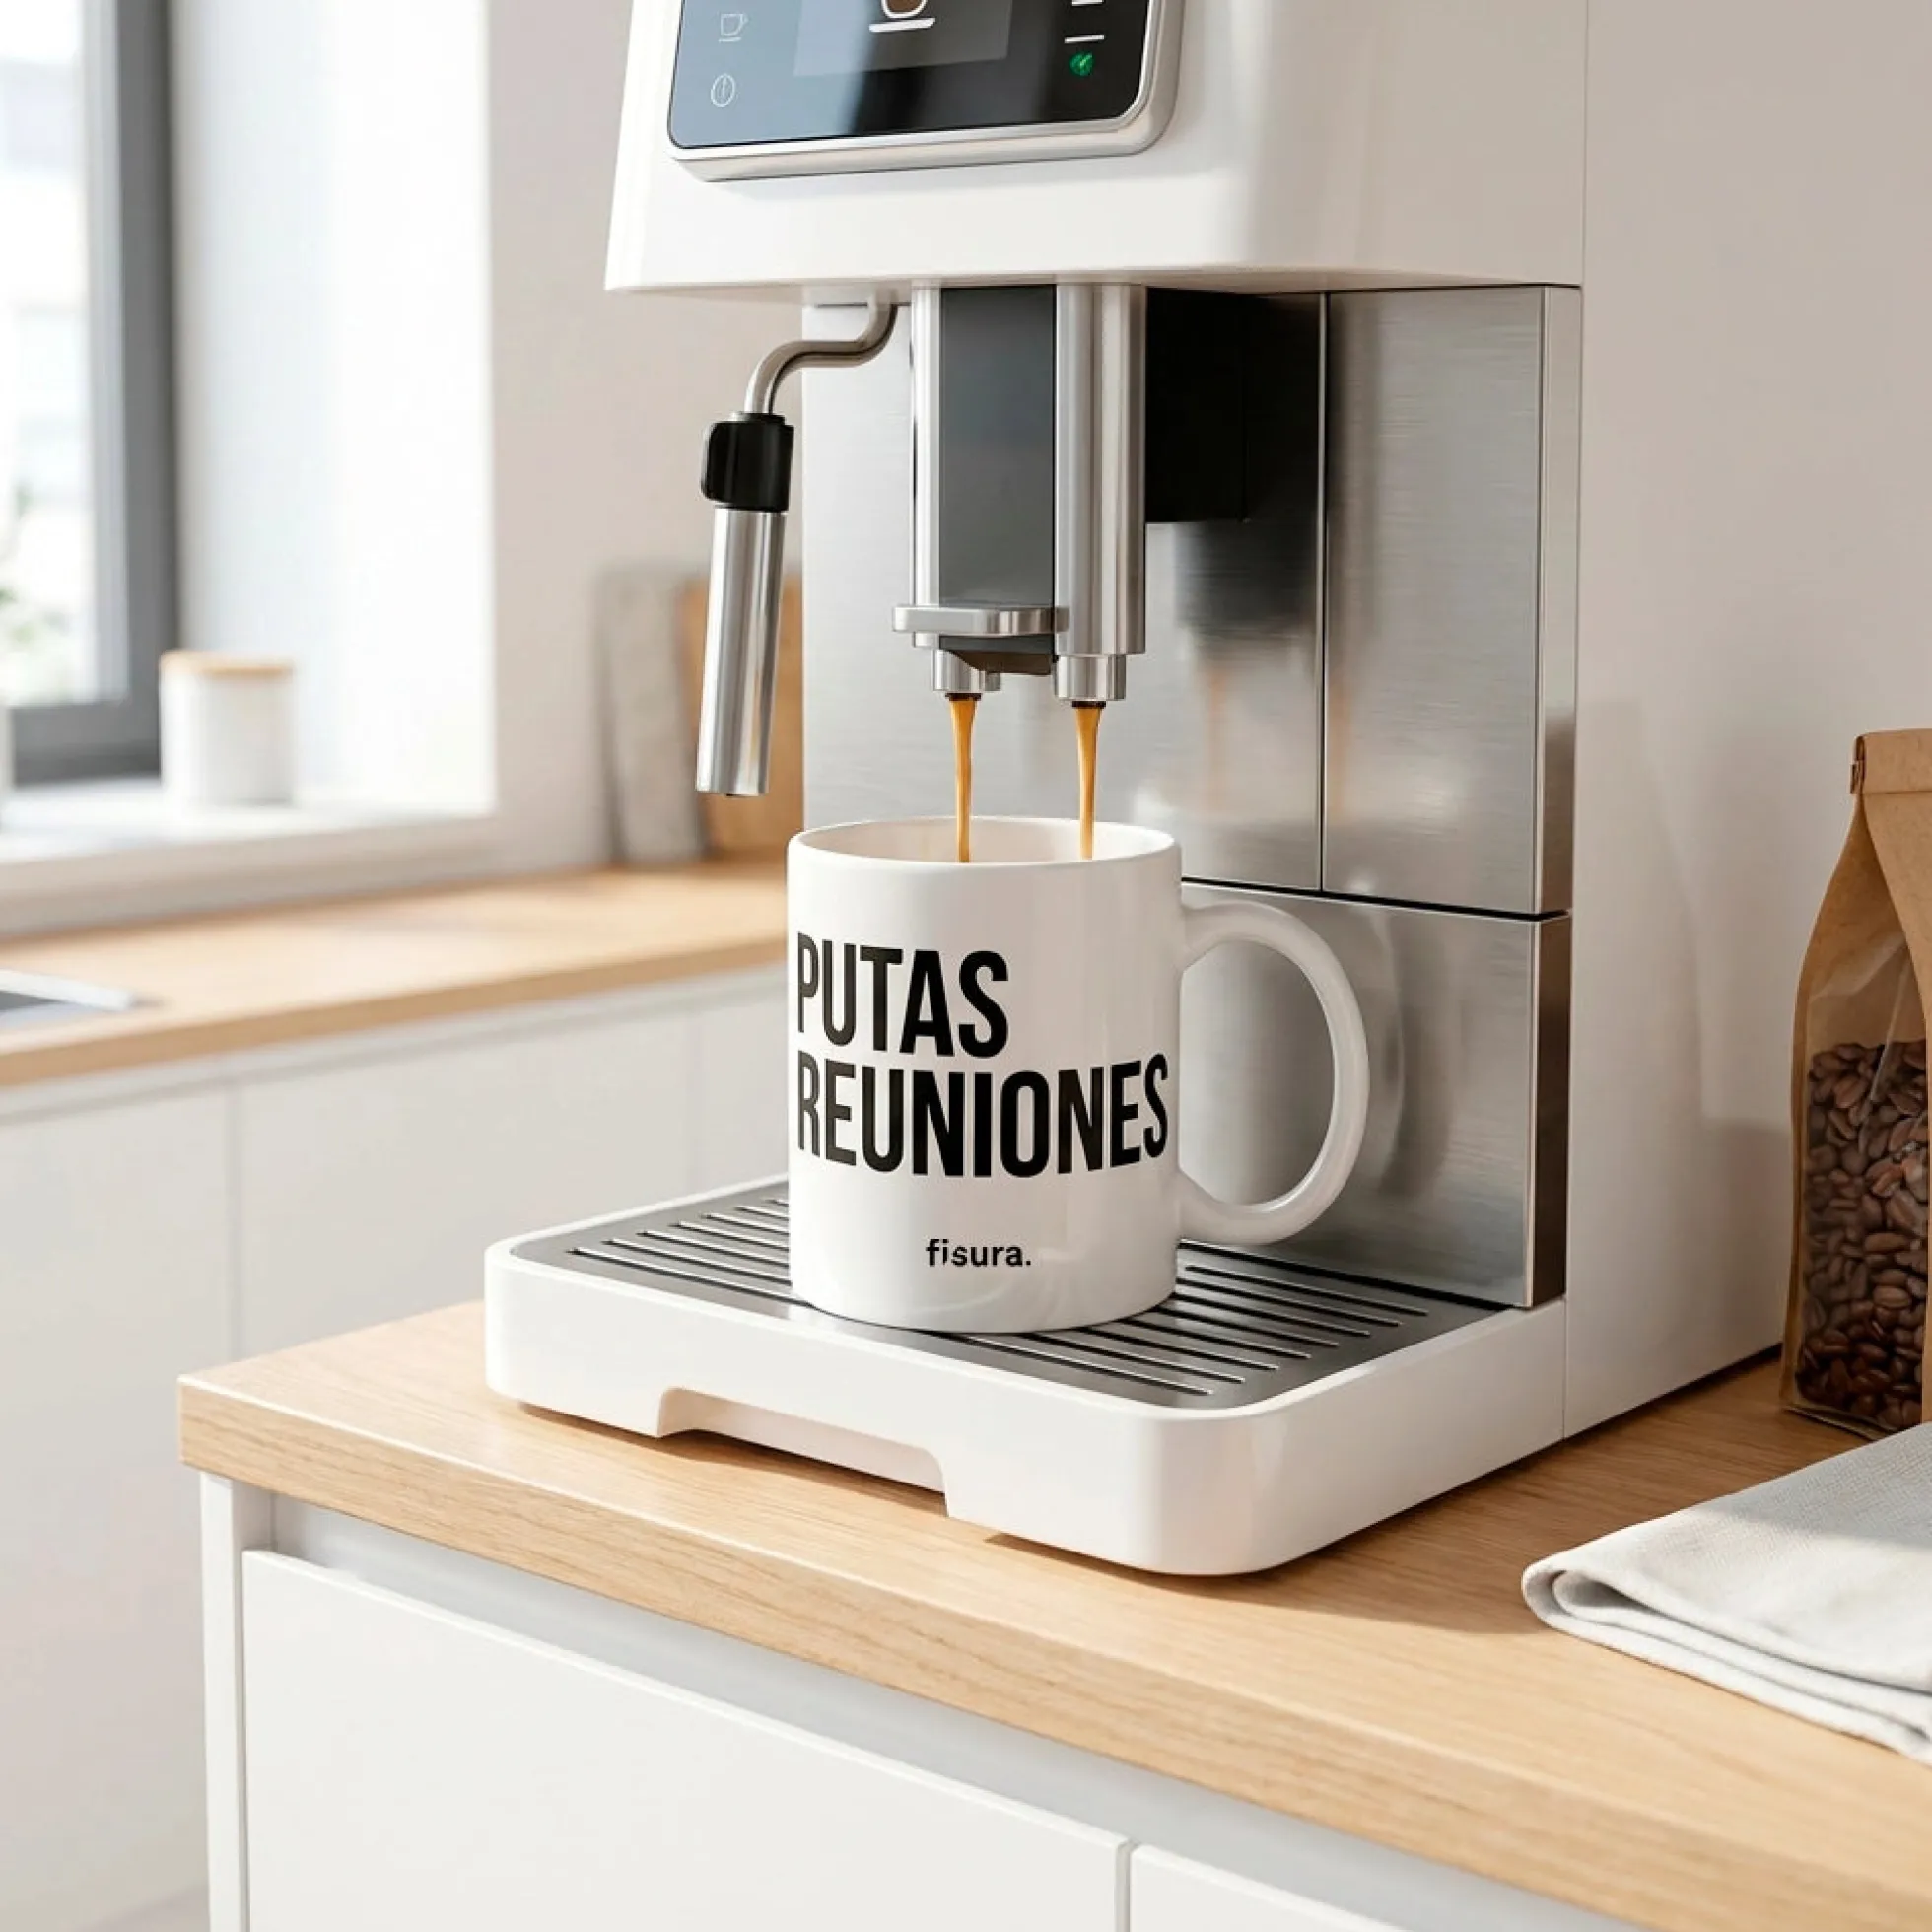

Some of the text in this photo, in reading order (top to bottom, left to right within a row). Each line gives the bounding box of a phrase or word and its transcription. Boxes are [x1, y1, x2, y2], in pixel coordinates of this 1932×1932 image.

[797, 932, 1009, 1059] PUTAS
[797, 1050, 1169, 1179] REUNIONES
[925, 1238, 1032, 1268] fisura.
